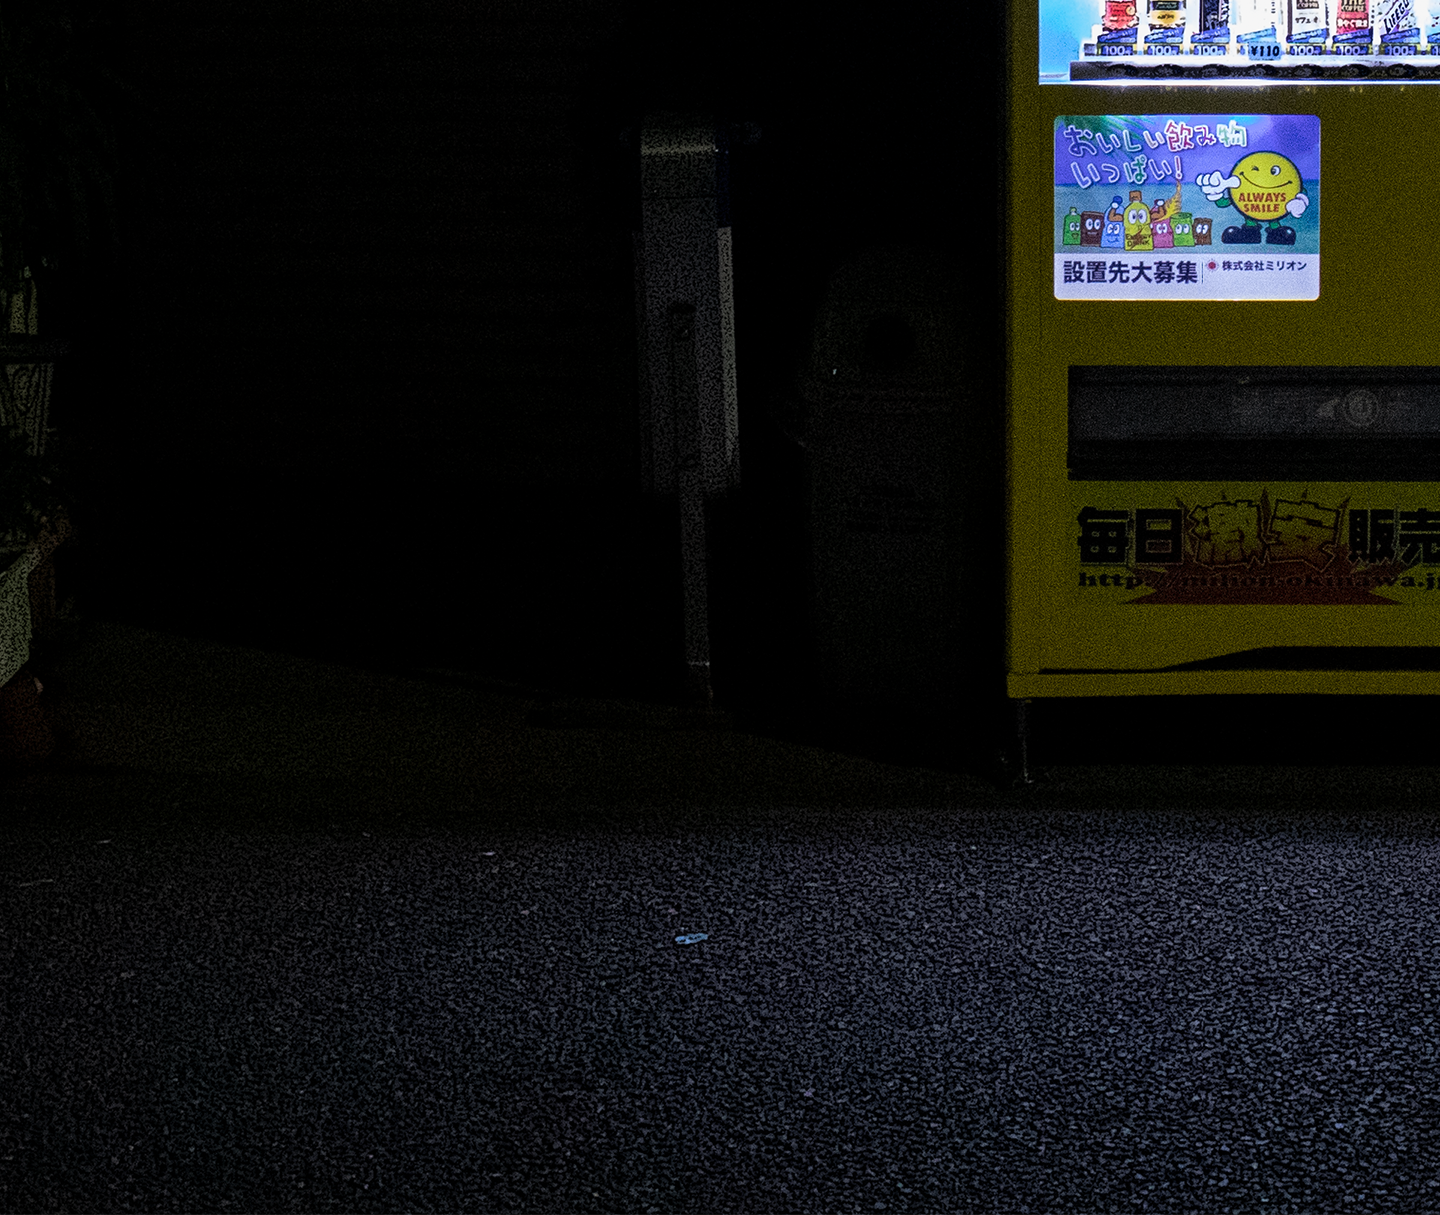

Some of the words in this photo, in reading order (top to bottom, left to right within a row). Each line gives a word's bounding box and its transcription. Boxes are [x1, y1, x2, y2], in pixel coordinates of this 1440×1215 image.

[1250, 45, 1280, 56] ¥110
[1063, 119, 1248, 157] おいしい飲み物
[1070, 155, 1184, 190] いっぱい!
[1238, 192, 1287, 204] ALWAYS
[1243, 203, 1280, 214] SMILE
[1063, 261, 1198, 284] 設置先大募集
[1222, 261, 1308, 272] 株式会社ミリオン
